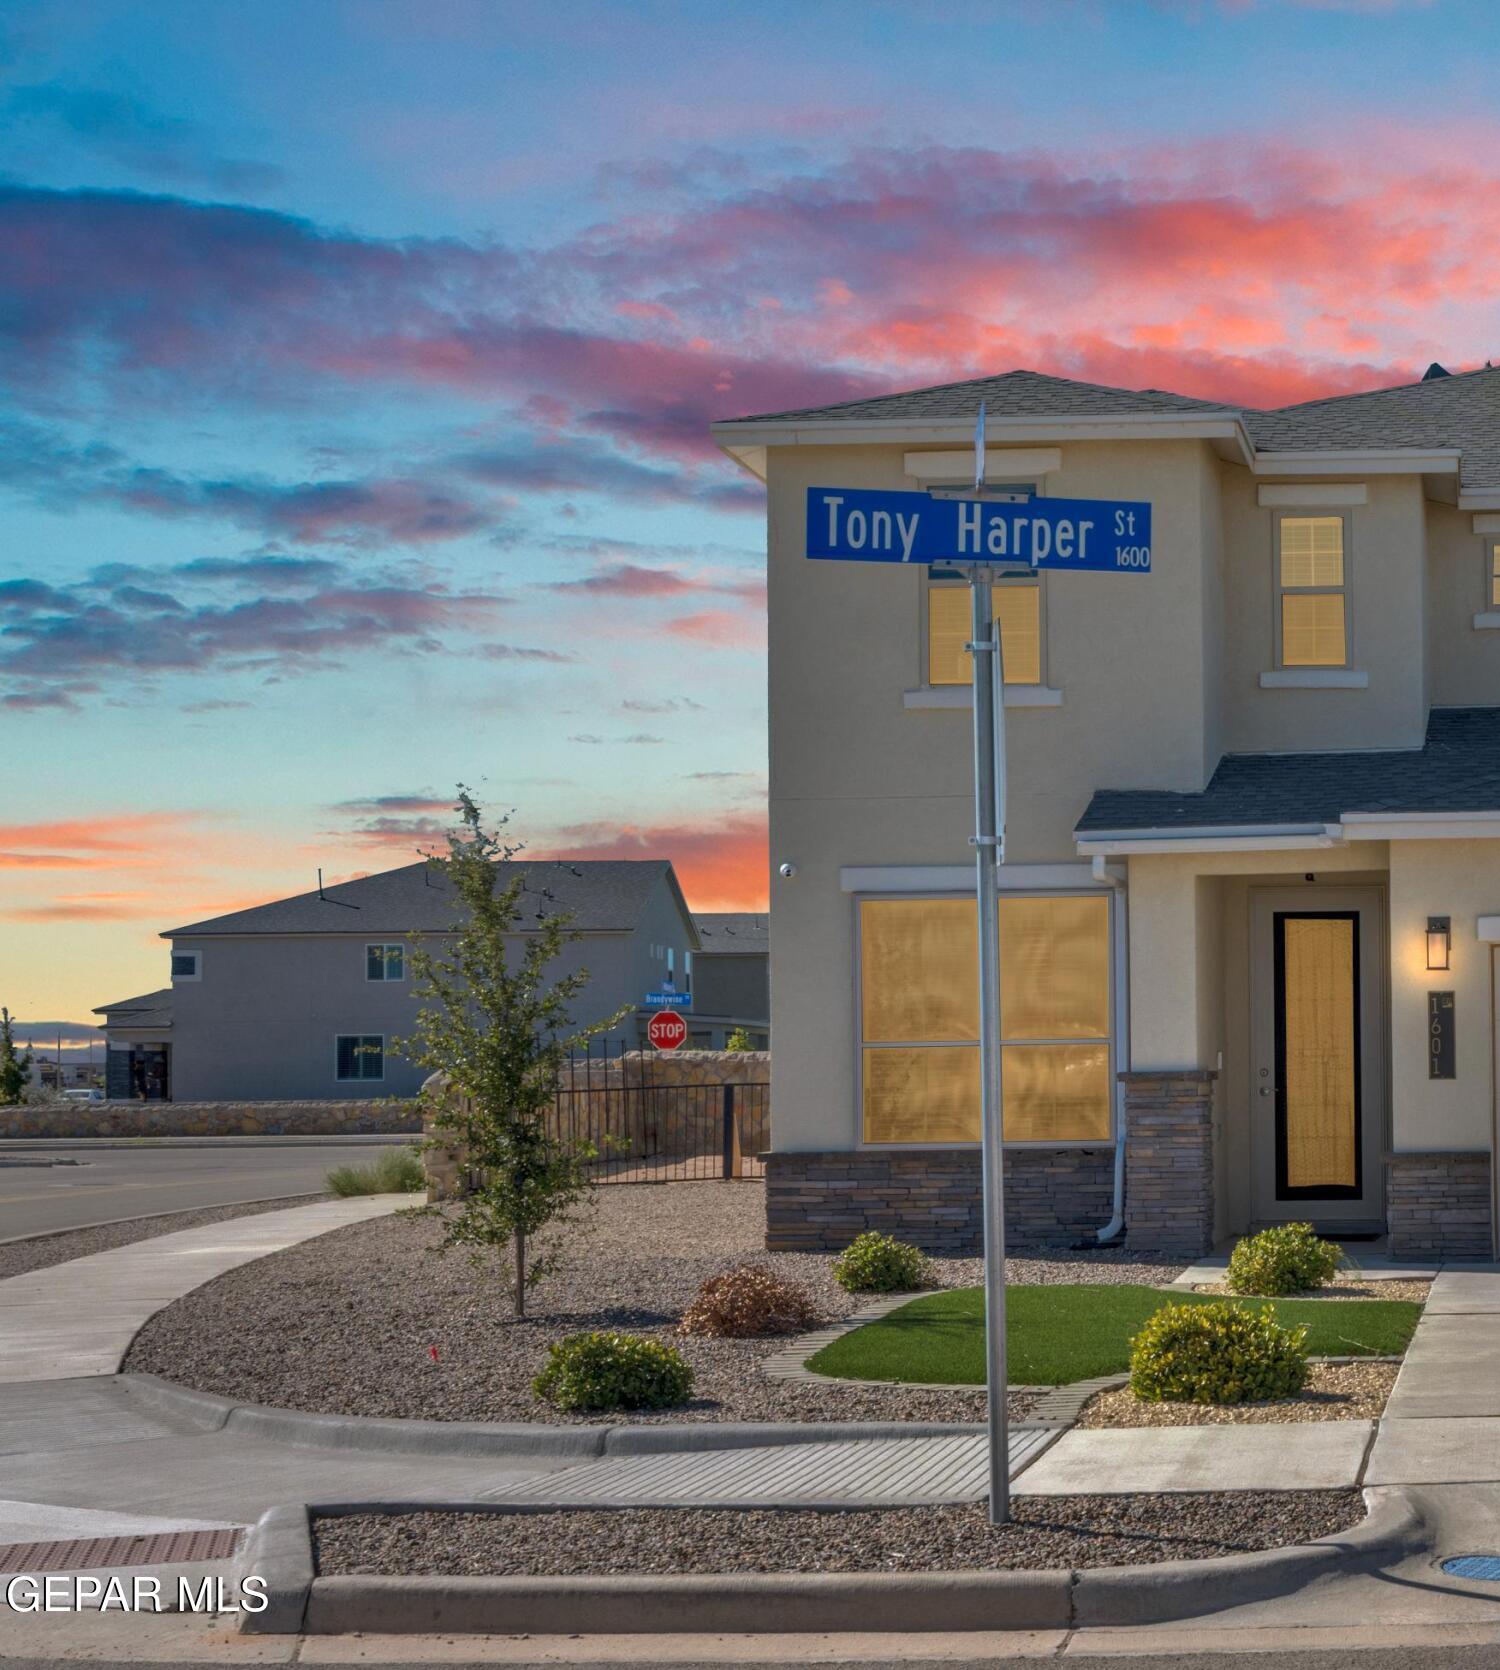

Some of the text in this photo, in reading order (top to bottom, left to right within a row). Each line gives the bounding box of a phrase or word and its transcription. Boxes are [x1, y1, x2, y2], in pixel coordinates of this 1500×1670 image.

[823, 496, 1136, 568] Tony Harper St
[1115, 546, 1150, 568] 1600
[651, 1023, 684, 1038] STOP
[1431, 997, 1441, 1075] 1601
